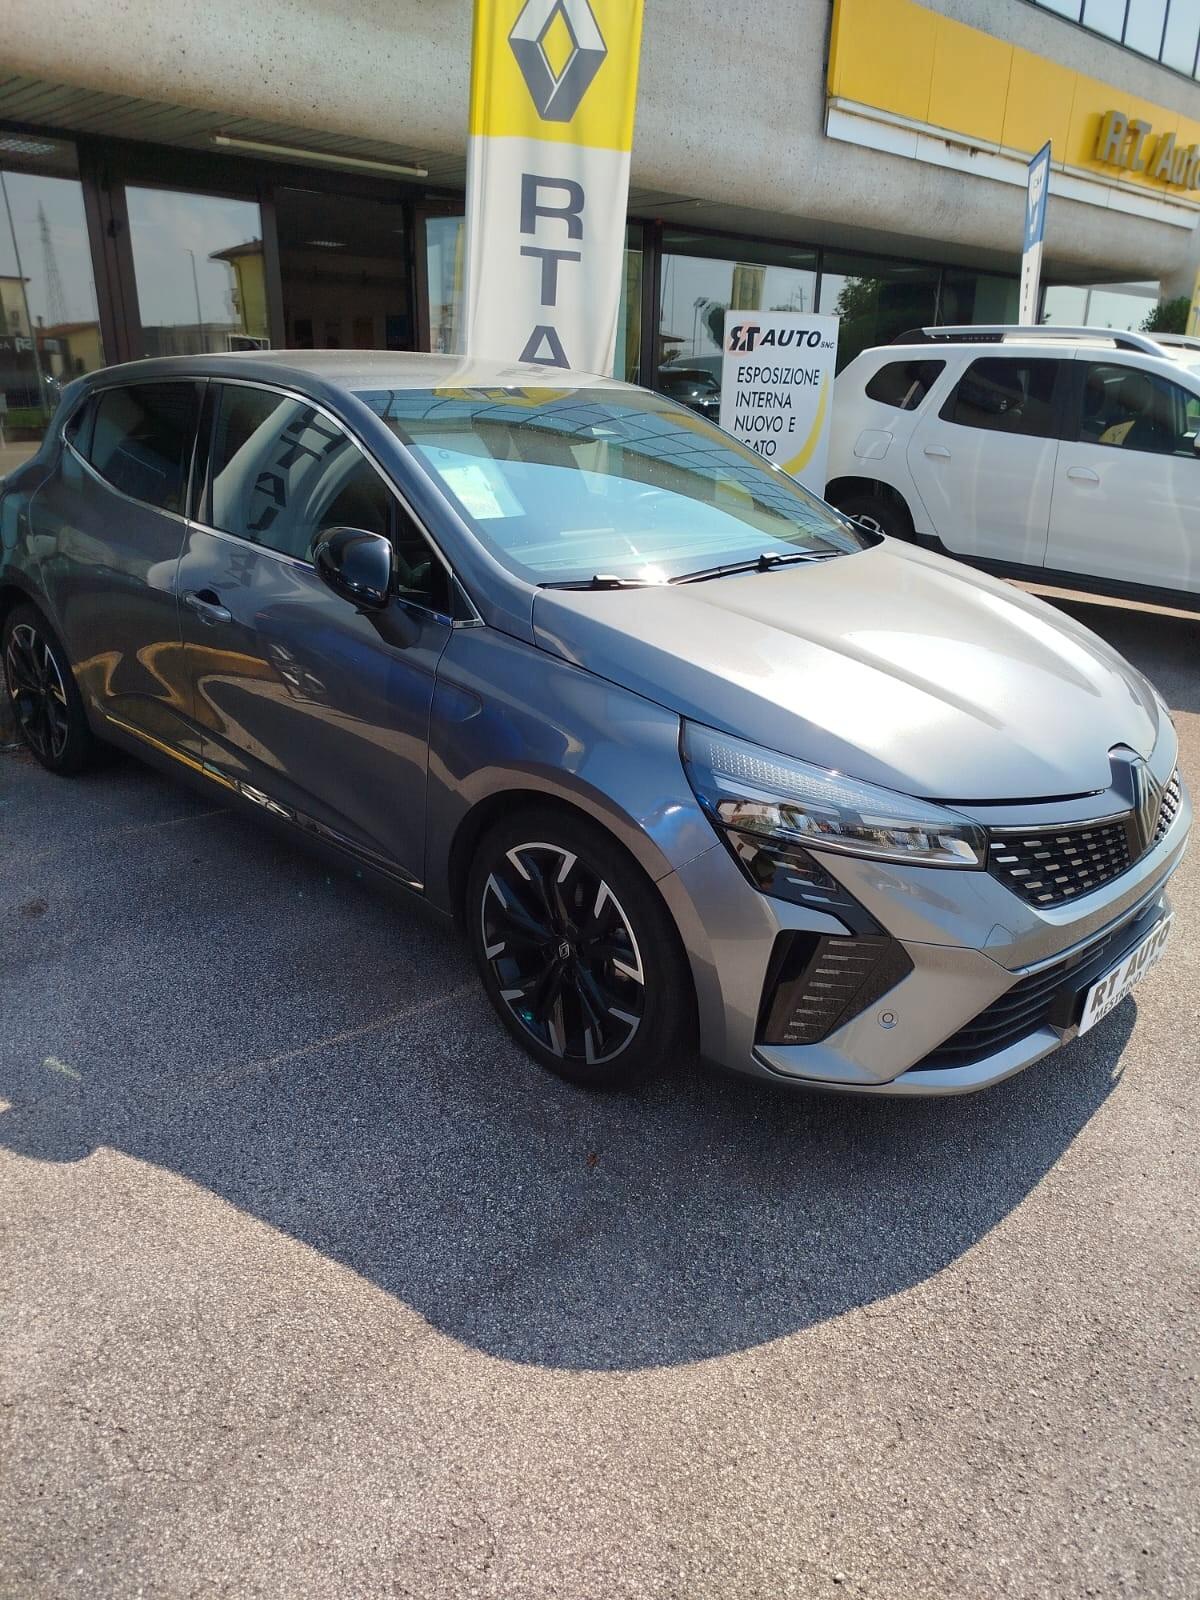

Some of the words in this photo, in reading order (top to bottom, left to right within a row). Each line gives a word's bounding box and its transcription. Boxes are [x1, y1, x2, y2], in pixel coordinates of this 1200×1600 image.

[760, 329, 821, 347] AUTO
[737, 366, 820, 386] ESPOSIZIONE
[735, 391, 792, 408] INTERNA
[734, 415, 783, 433] NUOVO
[788, 416, 796, 433] E
[740, 439, 777, 456] ATO
[1090, 968, 1121, 1014] RT
[1122, 920, 1171, 985] AUTO
